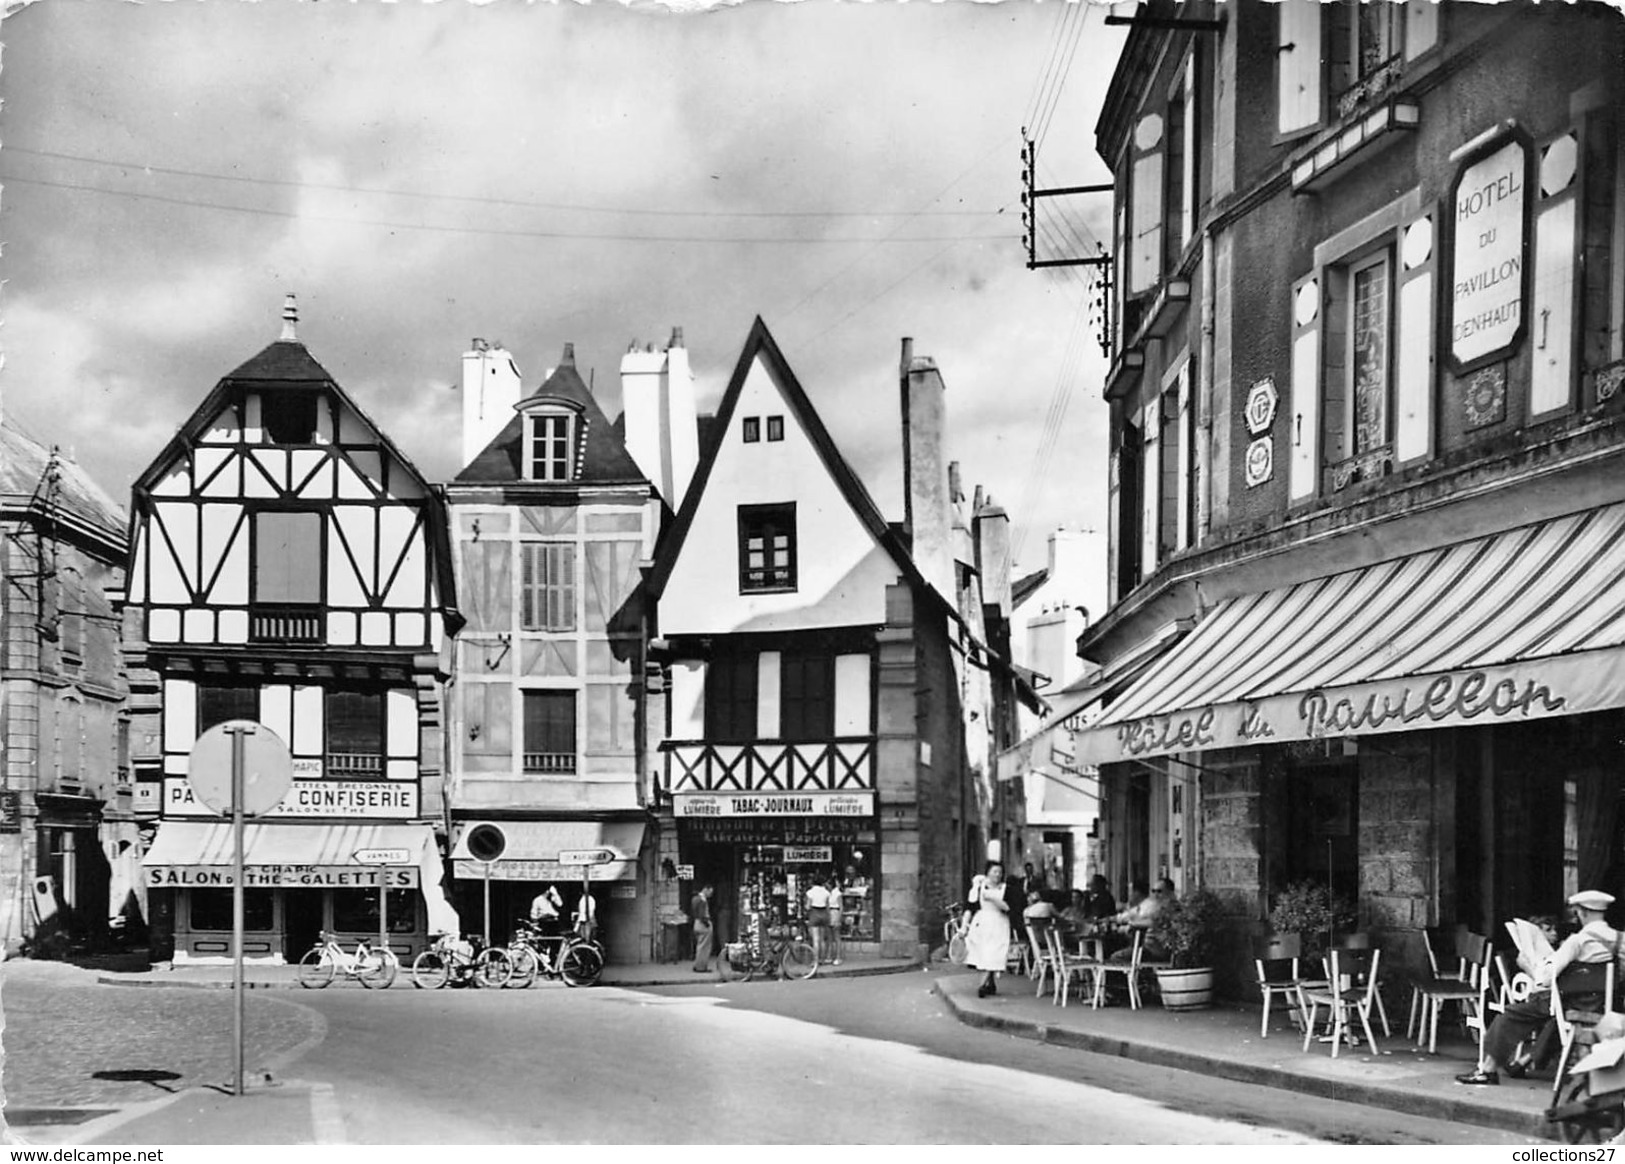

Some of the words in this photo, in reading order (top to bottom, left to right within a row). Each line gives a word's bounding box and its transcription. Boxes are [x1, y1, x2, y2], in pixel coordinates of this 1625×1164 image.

[1479, 229, 1497, 248] DU
[1455, 256, 1521, 299] PAVILLON
[1118, 706, 1214, 755] Hôtel
[1300, 672, 1566, 738] Pavillon
[299, 791, 410, 807] CONFISERIE
[732, 798, 814, 814] TABAC-JOURNAUX
[151, 869, 222, 884] SALON
[300, 871, 411, 885] GALETTES
